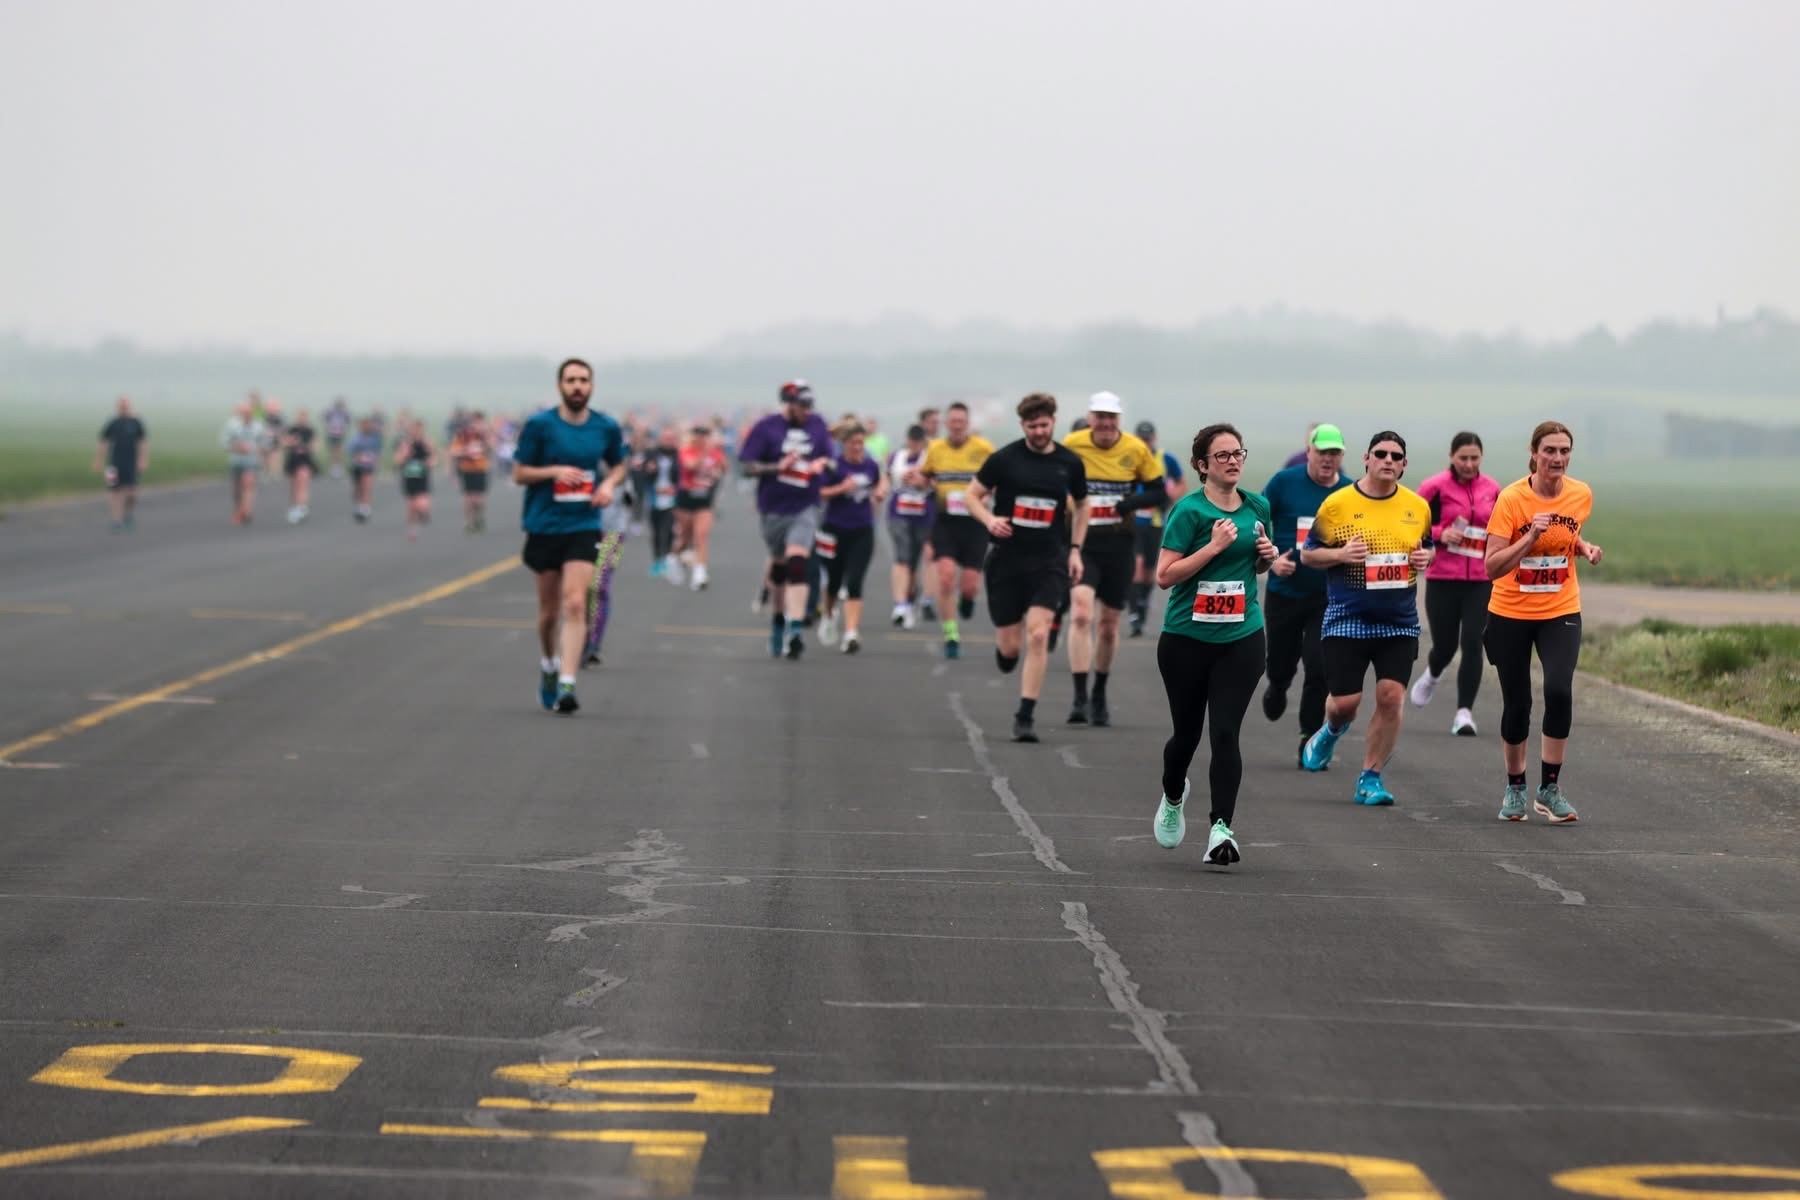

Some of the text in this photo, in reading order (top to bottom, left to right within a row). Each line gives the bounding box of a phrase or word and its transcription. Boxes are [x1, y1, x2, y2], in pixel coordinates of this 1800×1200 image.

[1377, 566, 1402, 581] 608
[1532, 569, 1557, 585] 784
[1205, 595, 1235, 614] 829
